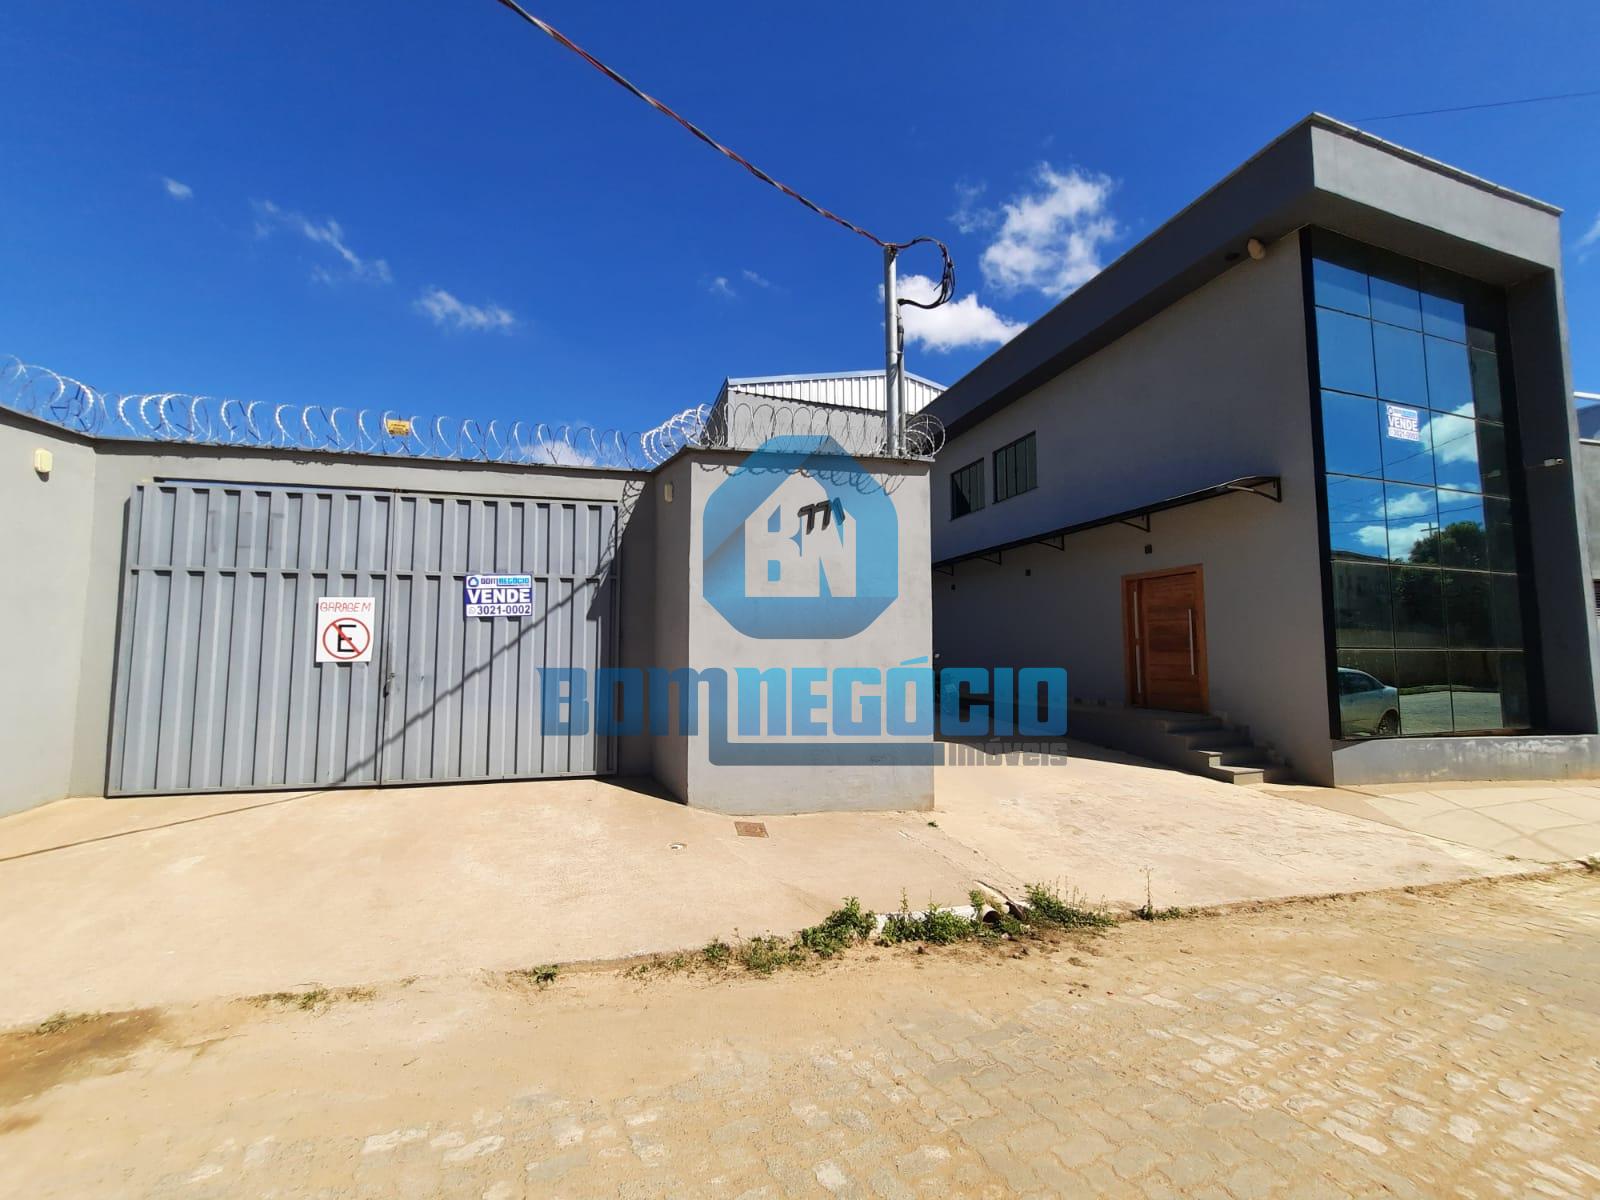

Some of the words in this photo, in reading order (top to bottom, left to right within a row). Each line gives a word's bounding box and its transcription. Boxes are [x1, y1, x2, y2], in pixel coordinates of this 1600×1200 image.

[1388, 415, 1418, 431] VENDE
[467, 588, 531, 603] VENDE
[477, 604, 531, 615] 3021-0002
[337, 624, 357, 652] E
